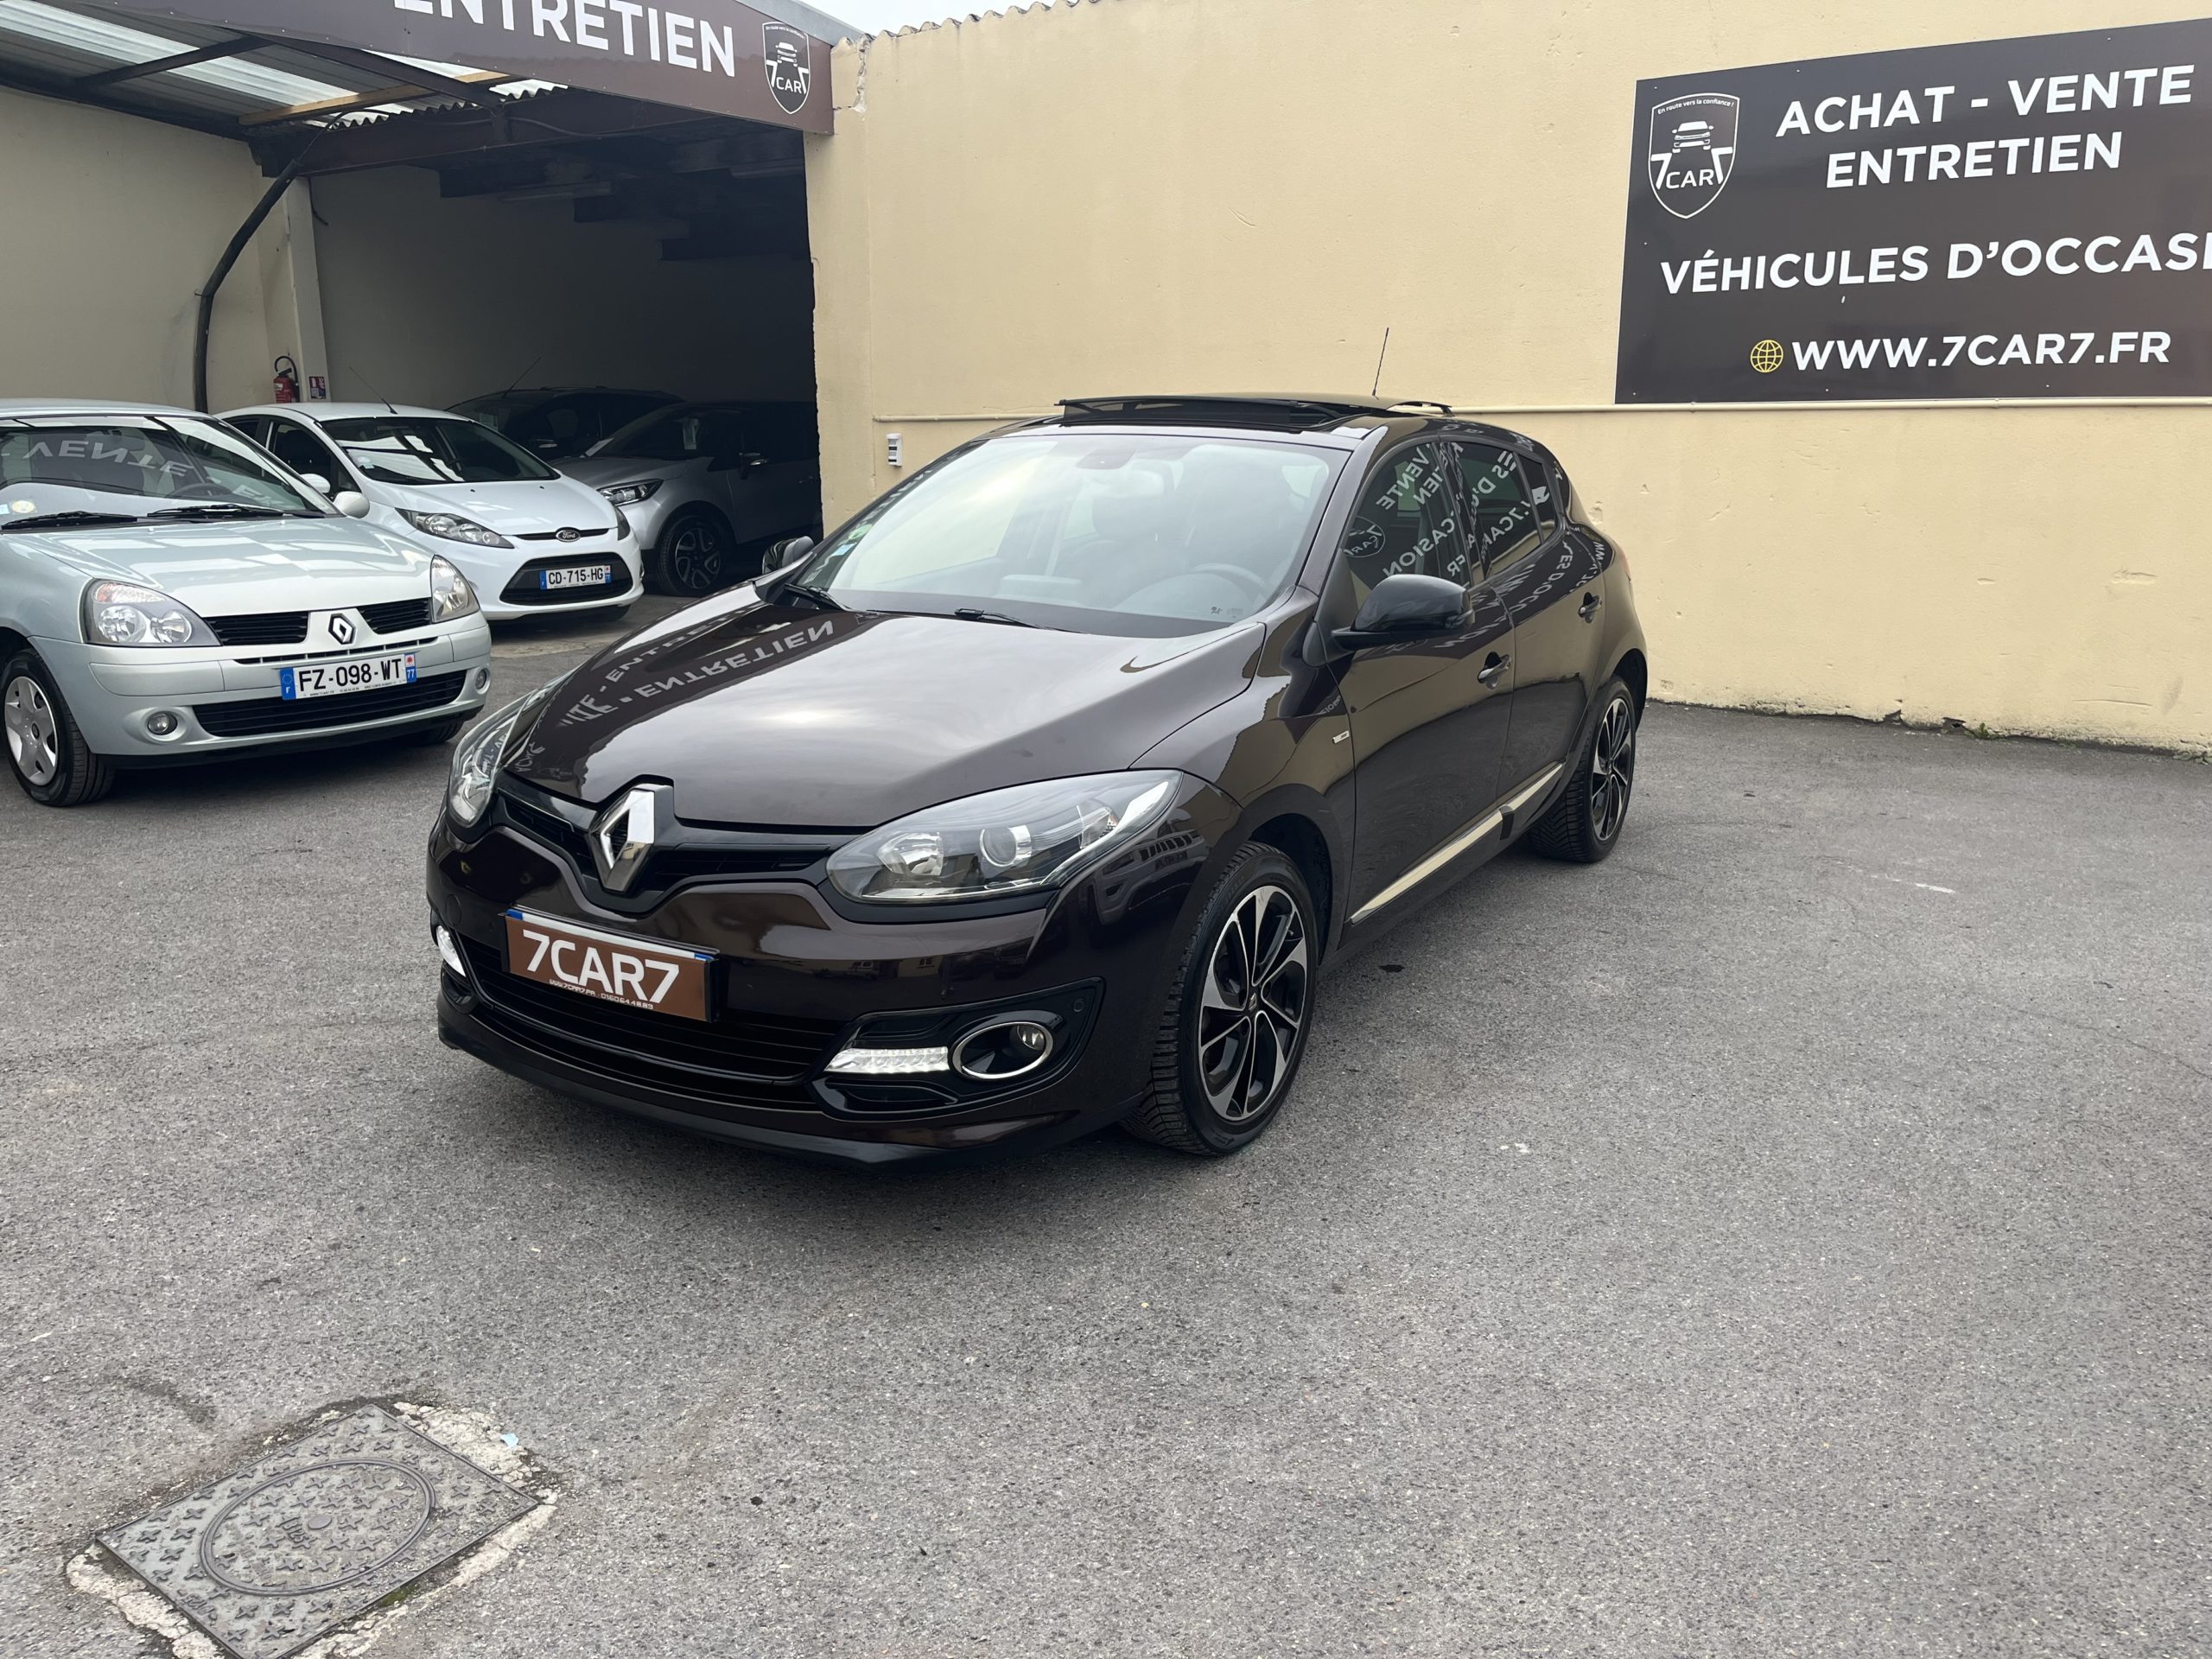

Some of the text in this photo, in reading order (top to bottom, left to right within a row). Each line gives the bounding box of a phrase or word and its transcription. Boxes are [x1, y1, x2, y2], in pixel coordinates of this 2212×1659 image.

[394, 0, 734, 77] TRETIEN
[1666, 102, 1682, 111] route
[1776, 86, 1955, 137] ACHAT
[2008, 65, 2194, 115] VENTE
[1827, 131, 2122, 188] ENTRETIEN
[1661, 249, 1929, 295] VÉHICULES
[1791, 332, 2171, 371] WWW.7CAR7.FR
[549, 568, 603, 585] CD-715-HG
[298, 658, 401, 691] FZ-098-WT
[406, 669, 415, 678] 77
[523, 929, 679, 1004] 7CAR7
